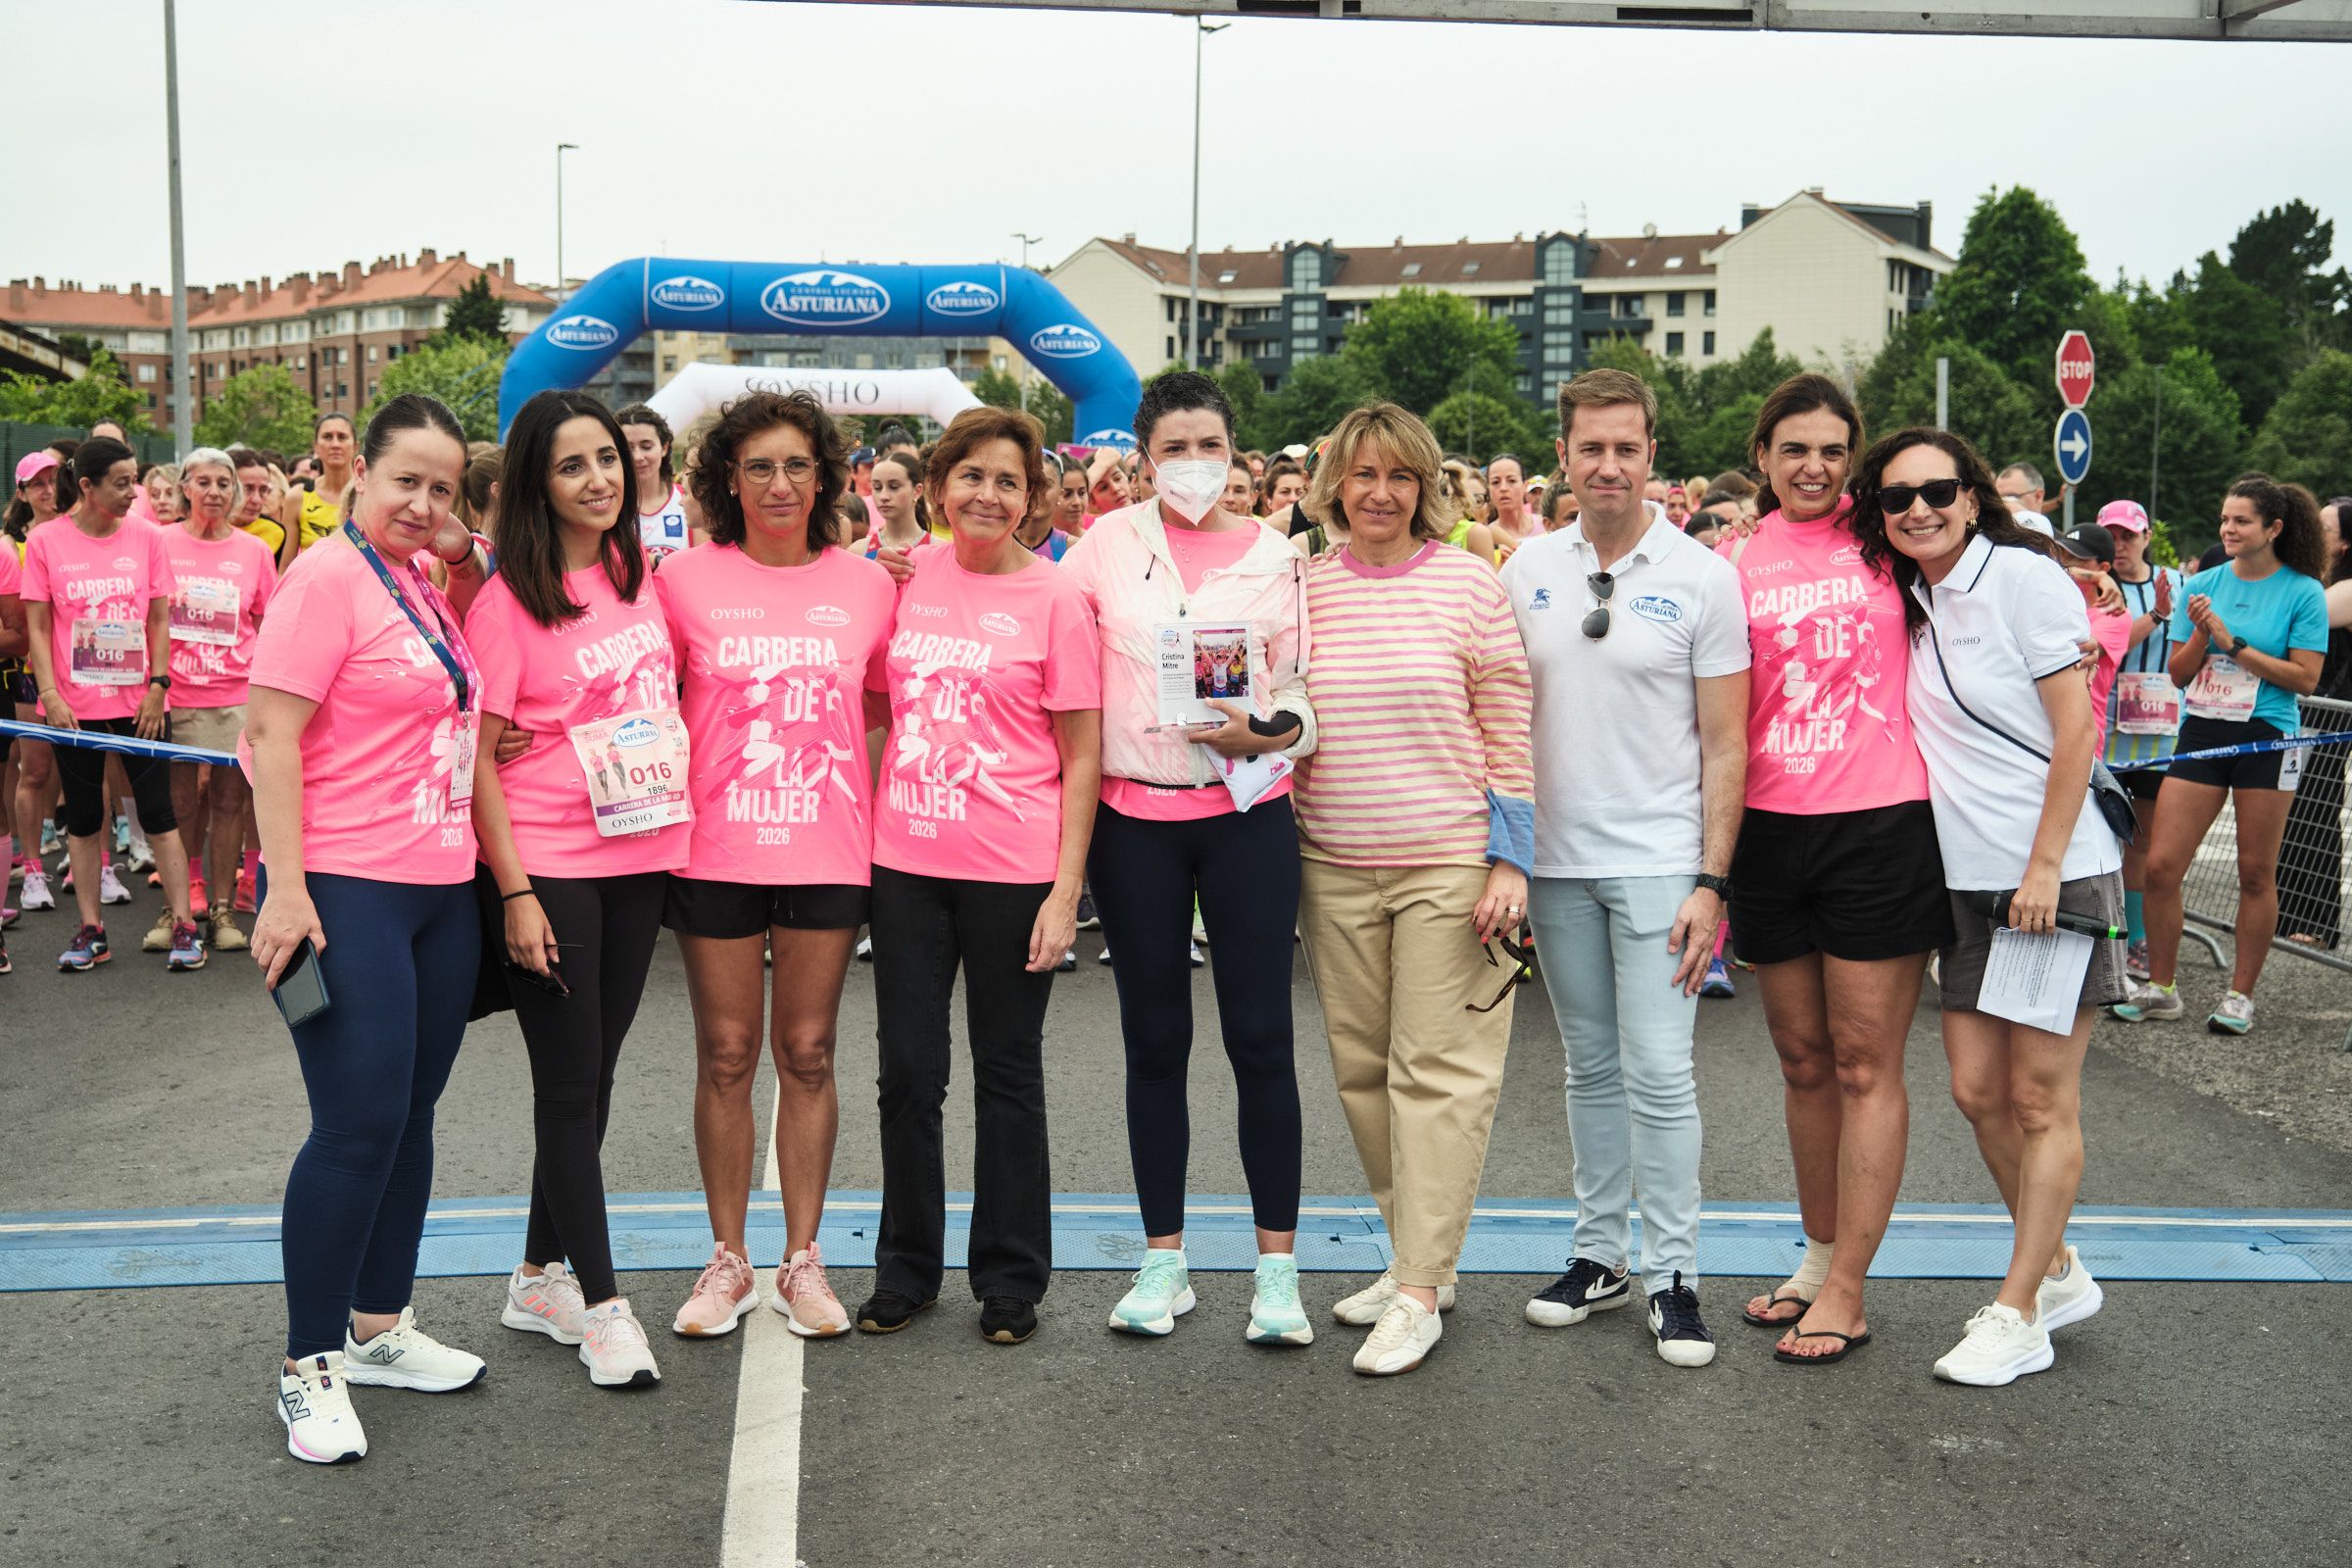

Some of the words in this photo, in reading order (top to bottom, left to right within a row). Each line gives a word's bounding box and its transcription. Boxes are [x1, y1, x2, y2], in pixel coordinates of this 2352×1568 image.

[659, 287, 717, 304] ASTURIANA
[771, 287, 880, 314] ASTURIANA
[934, 293, 992, 308] ASTURIANA
[554, 328, 612, 343] ASTURIANA
[2061, 361, 2092, 379] STOP
[1747, 560, 1793, 577] OYSHO
[66, 576, 136, 601] CARRERA
[1750, 575, 1868, 618] CARRERA
[187, 609, 215, 621] 016
[710, 608, 764, 620] OYSHO
[809, 612, 848, 623] ASTURIANA
[1634, 601, 1677, 619] ASTURIANA
[553, 611, 598, 636] OYSHO
[1814, 615, 1852, 660] DE
[1951, 635, 1981, 647] OYSHO
[95, 649, 124, 662] 016
[576, 619, 666, 679] CARRERA
[718, 636, 839, 668] CARRERA
[892, 629, 993, 671] CARRERA
[173, 655, 226, 675] MUJER
[784, 676, 824, 722] DE
[932, 676, 970, 724] DE
[2206, 684, 2231, 696] 016
[1805, 683, 1832, 719] LA
[2141, 701, 2166, 712] 016
[1762, 719, 1846, 755] MUJER
[629, 761, 672, 785] 016
[775, 747, 804, 788] LA
[919, 743, 948, 786] LA
[1785, 757, 1816, 774] 2026
[647, 784, 668, 796] 1896
[889, 778, 967, 821] MUJER
[613, 800, 643, 812] CARRERA
[643, 797, 652, 806] DE
[727, 788, 820, 823] MUJER
[612, 812, 653, 828] OYSHO
[908, 817, 938, 840] 2026
[757, 827, 791, 846] 2026
